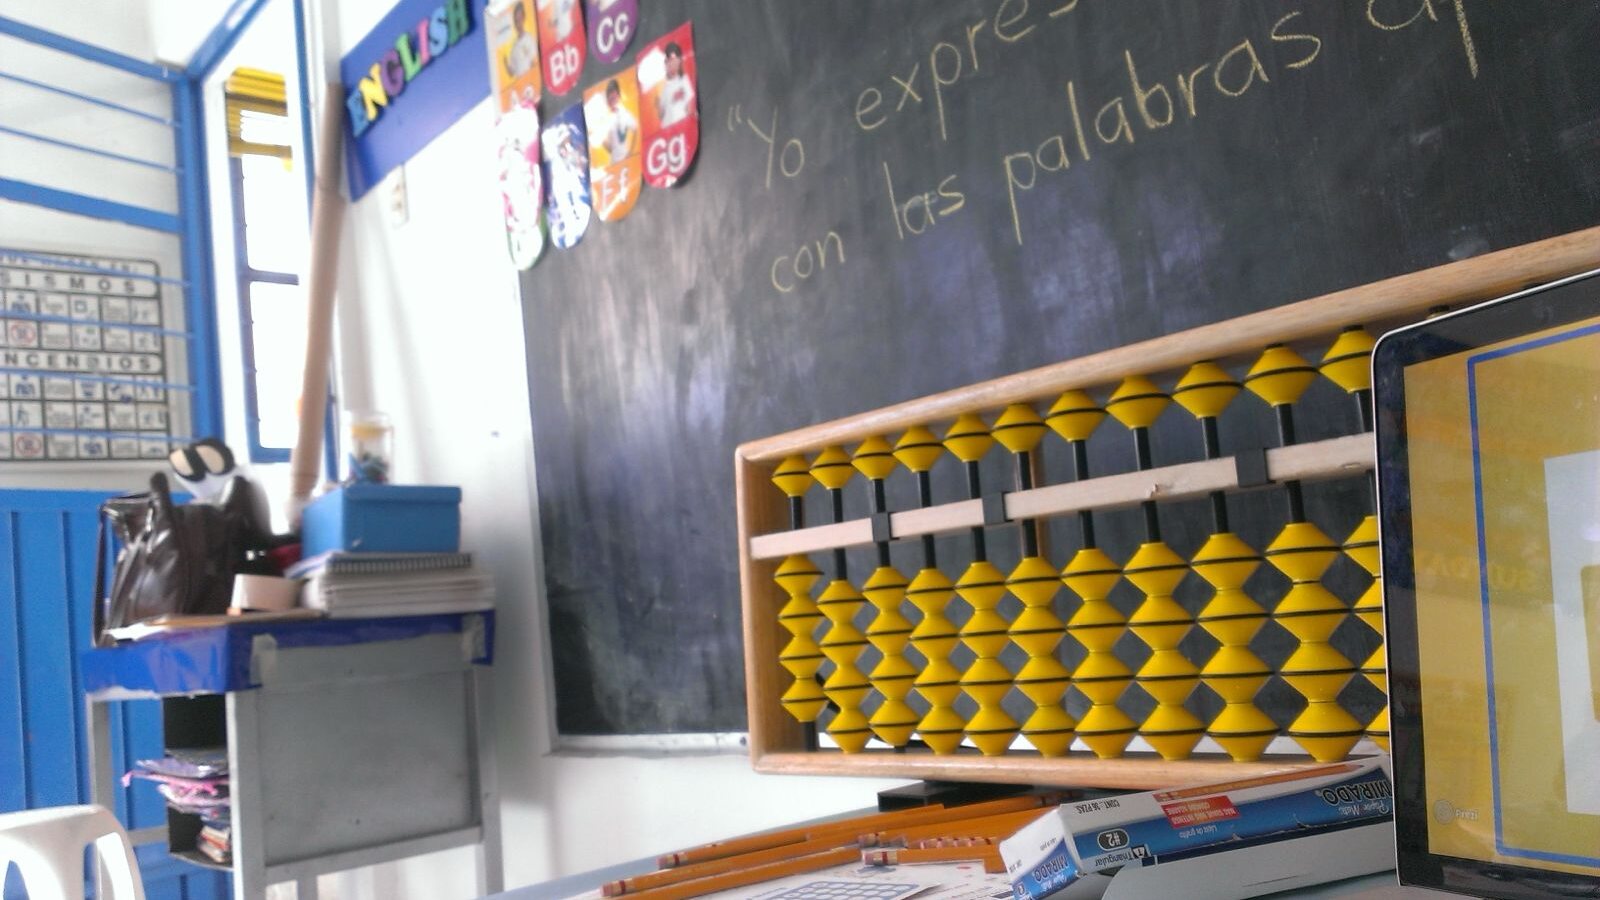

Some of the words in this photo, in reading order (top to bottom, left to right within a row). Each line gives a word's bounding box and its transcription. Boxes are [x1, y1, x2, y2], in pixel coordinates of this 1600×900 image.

[346, 0, 470, 138] ENGLISH
[549, 44, 579, 87] Bb
[646, 133, 686, 176] Gg
[771, 231, 846, 293] con
[883, 161, 965, 240] las
[1003, 10, 1322, 246] palabras
[1321, 780, 1392, 807] MIRADO
[1106, 831, 1121, 847] #2
[1033, 854, 1070, 883] MIRADO
[1095, 850, 1133, 868] Triangular
